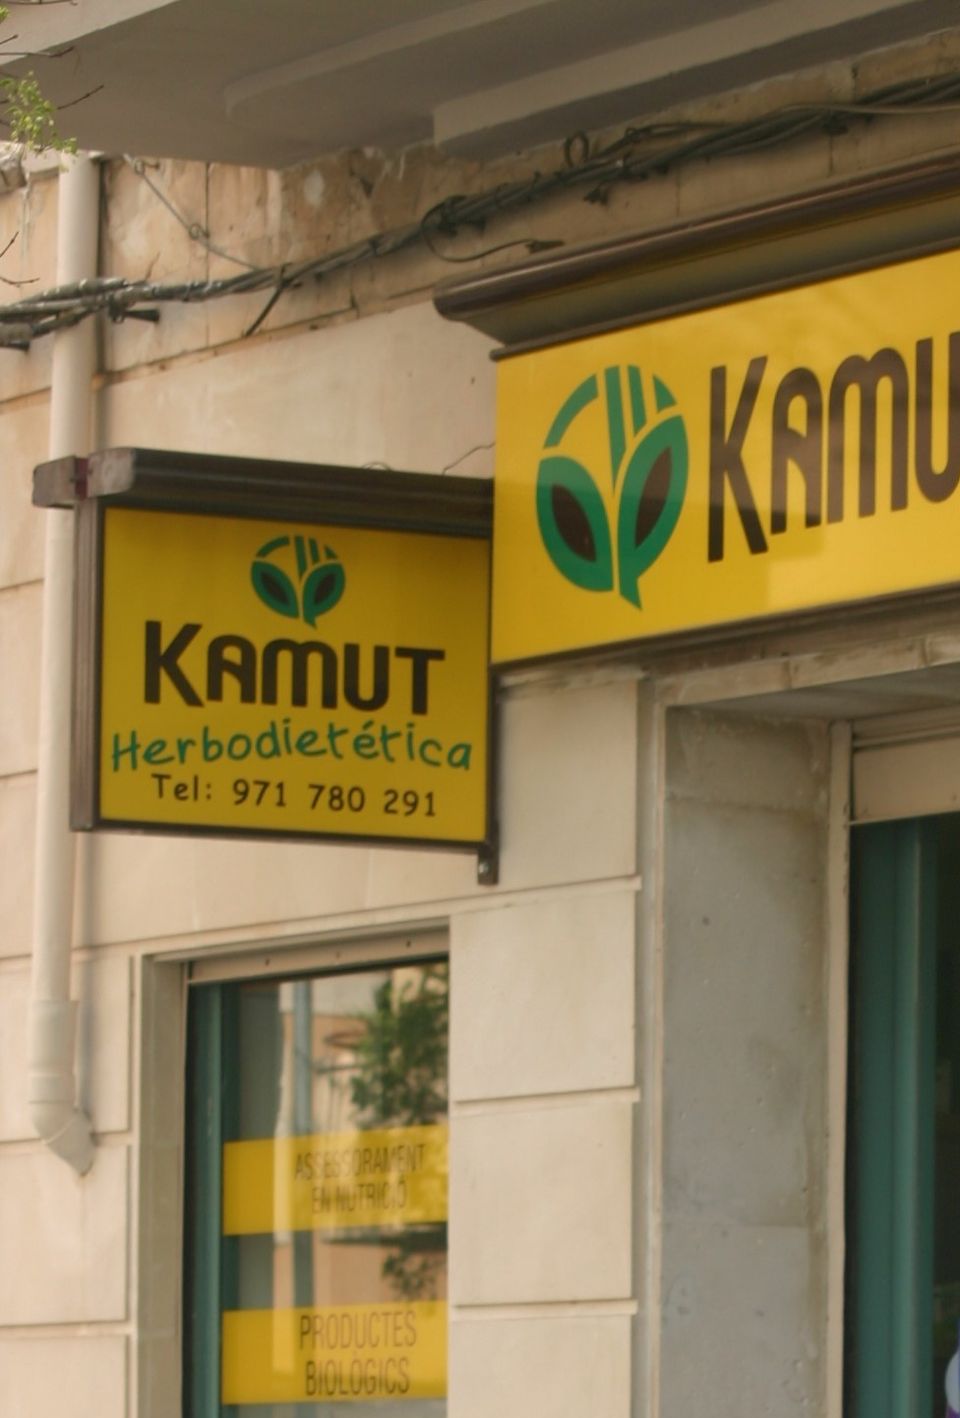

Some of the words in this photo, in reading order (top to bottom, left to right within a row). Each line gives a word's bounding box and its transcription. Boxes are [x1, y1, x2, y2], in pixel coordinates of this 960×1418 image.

[144, 620, 446, 716] KAMUT
[112, 718, 472, 773] Herbodietética
[151, 774, 213, 802] Tel:
[233, 779, 286, 807] 971
[309, 784, 366, 813] 780
[383, 788, 436, 817] 291
[294, 1143, 426, 1181] ASSESSORAMENT
[311, 1187, 331, 1214] EN
[299, 1310, 417, 1351] PRODUCTES
